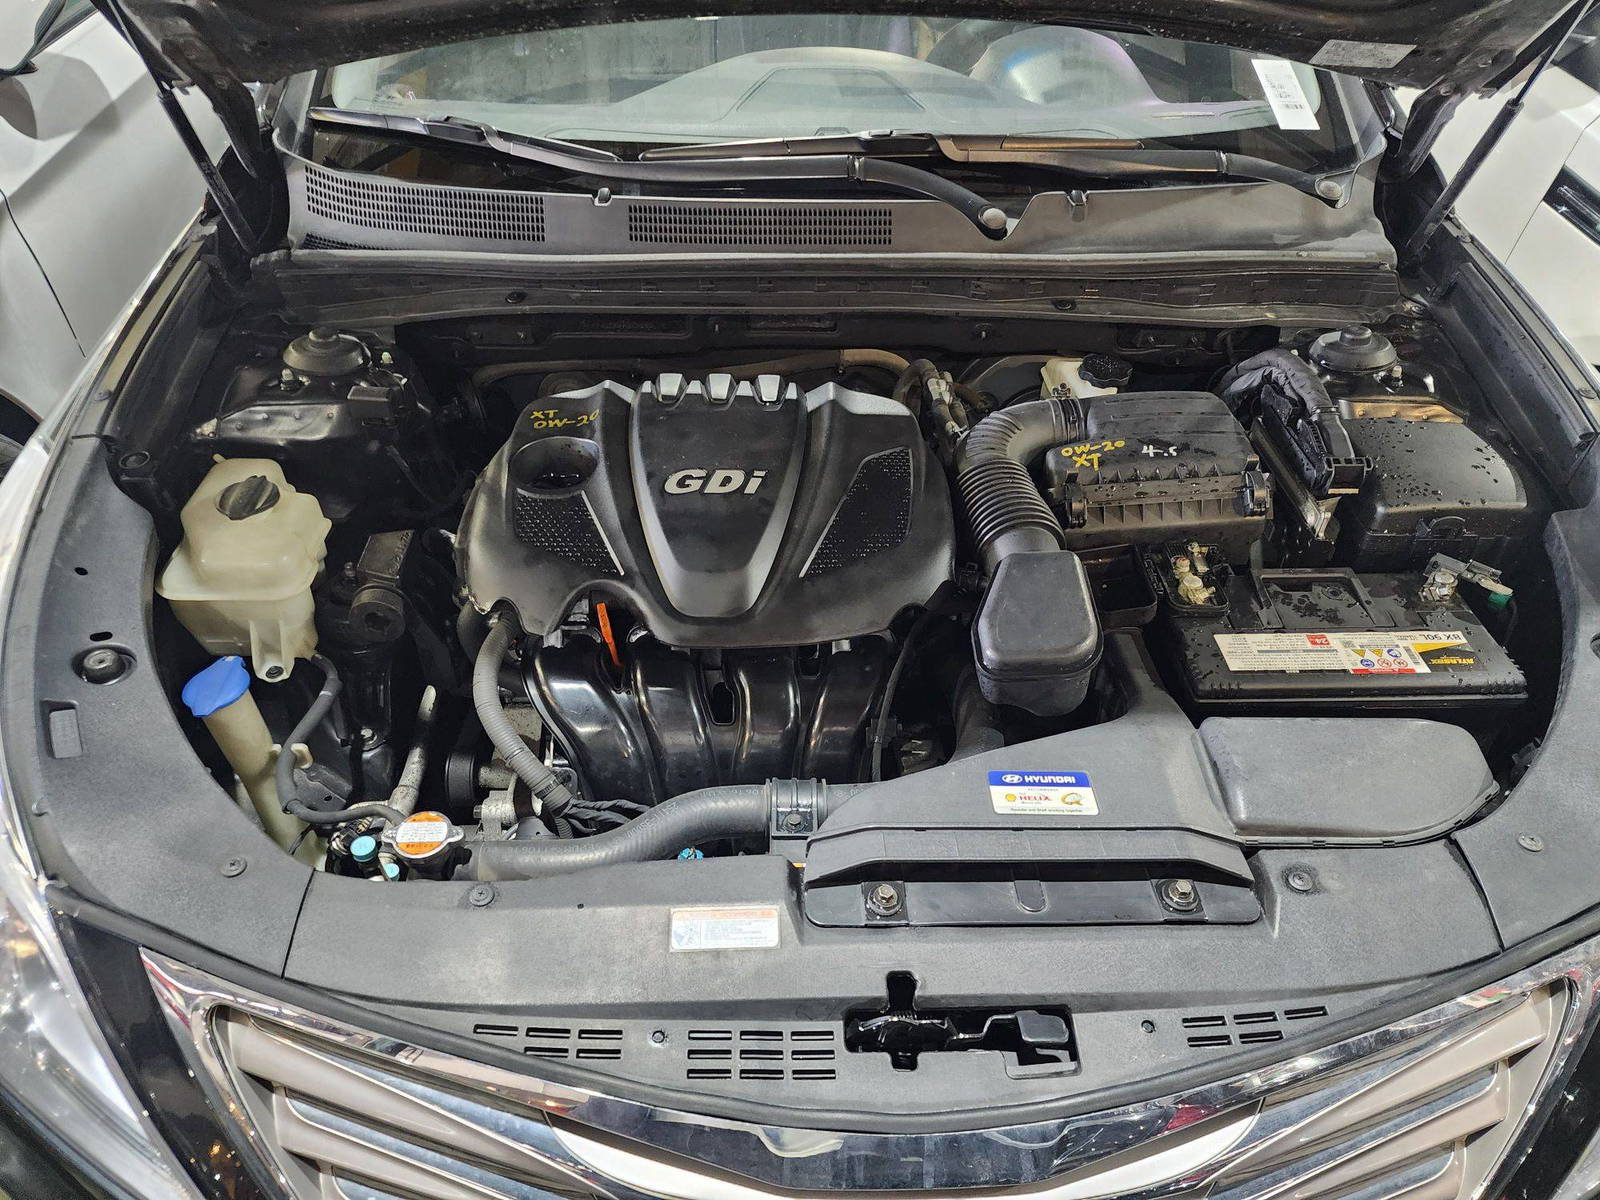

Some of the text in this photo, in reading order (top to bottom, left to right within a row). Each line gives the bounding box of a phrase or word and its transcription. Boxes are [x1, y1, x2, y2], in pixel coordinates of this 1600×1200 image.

[530, 409, 558, 419] XT
[1072, 453, 1101, 471] XT
[664, 469, 767, 494] GDi
[1024, 775, 1076, 783] HYUNDAI
